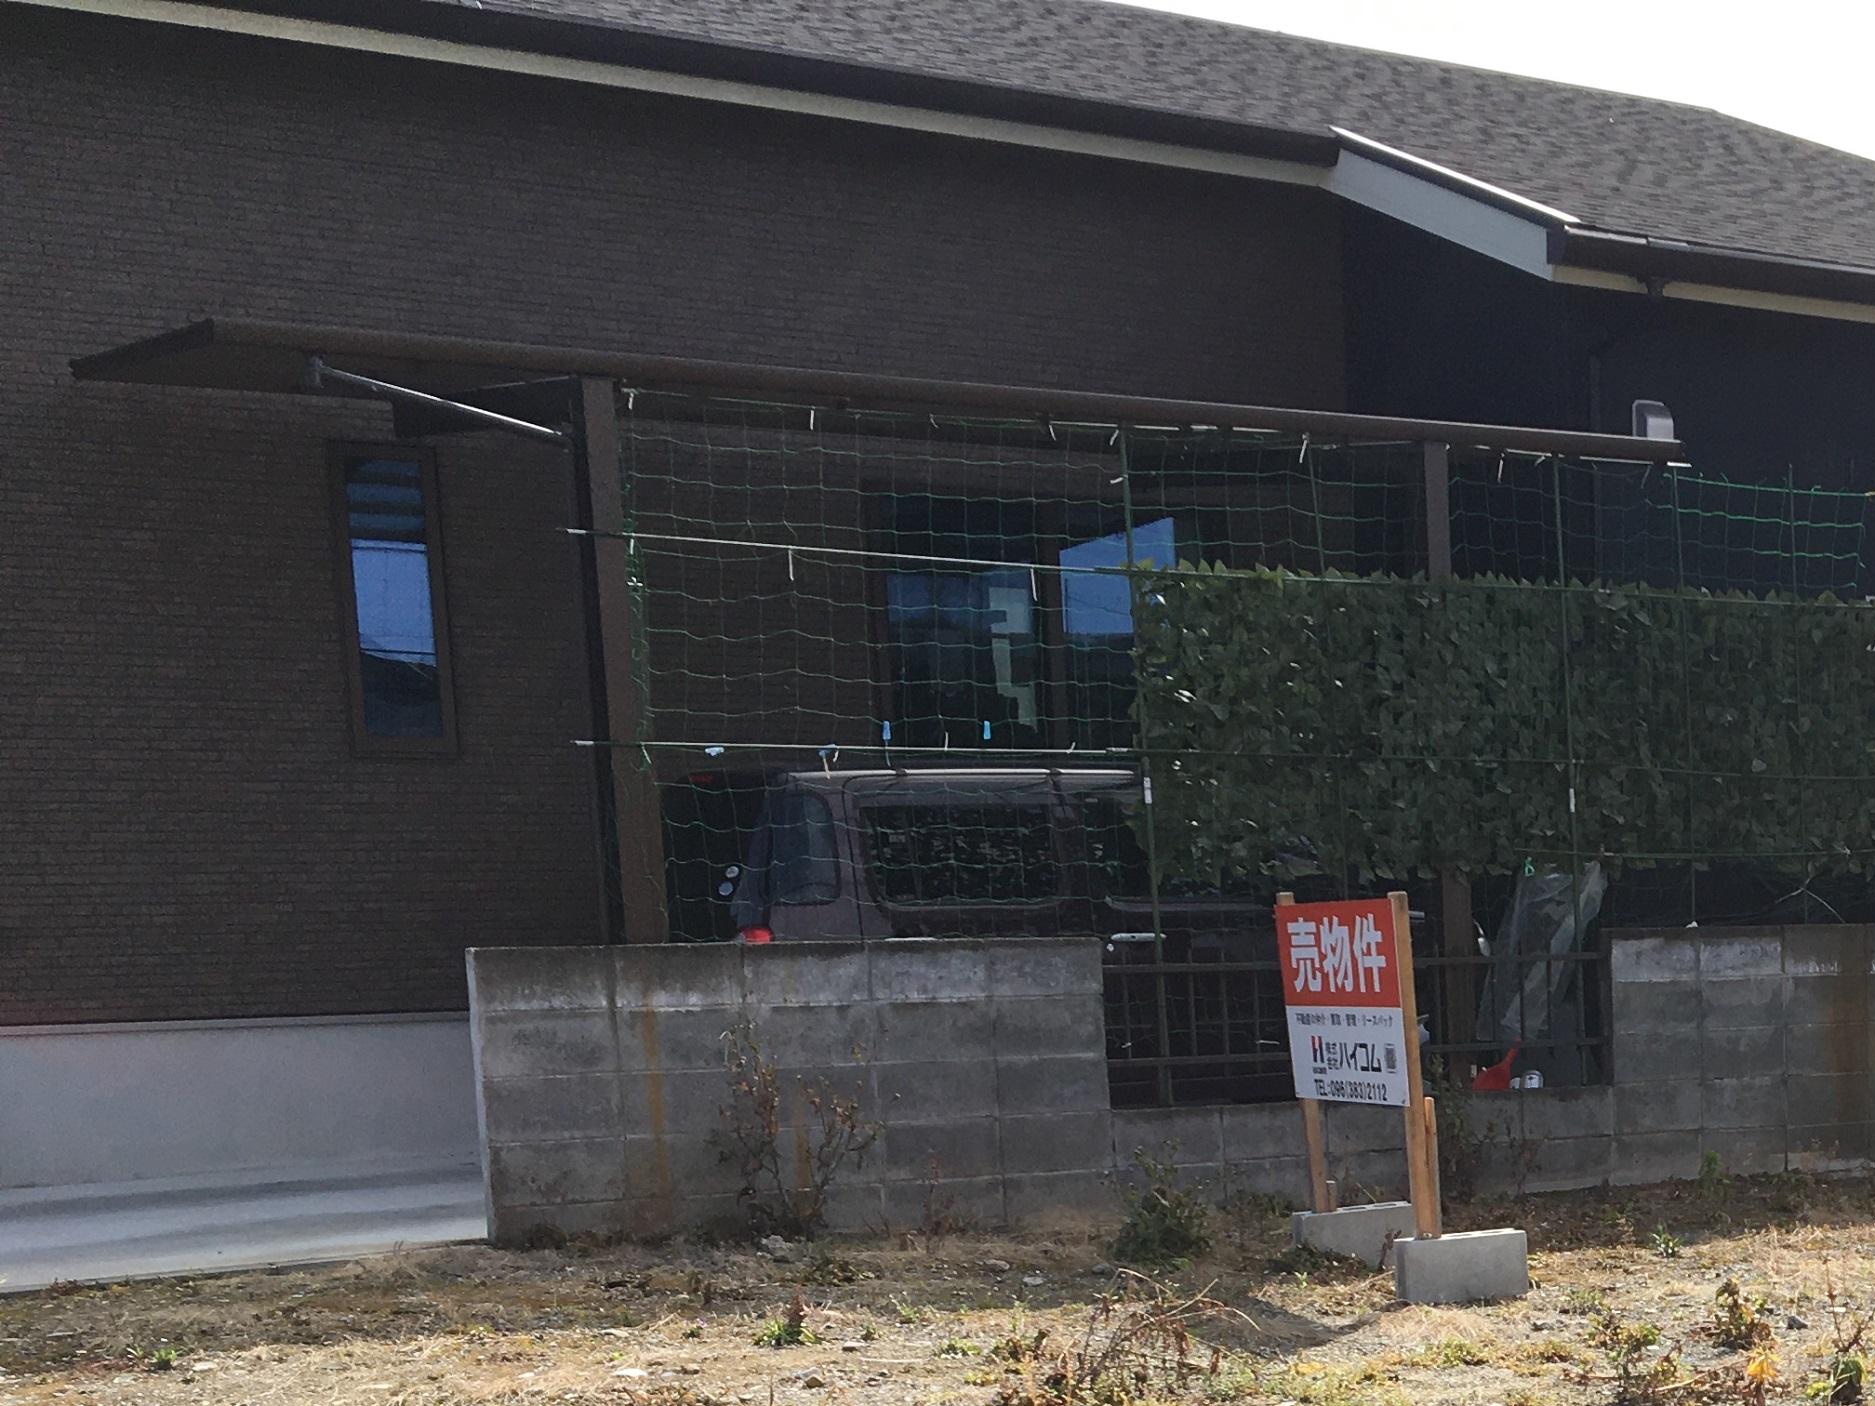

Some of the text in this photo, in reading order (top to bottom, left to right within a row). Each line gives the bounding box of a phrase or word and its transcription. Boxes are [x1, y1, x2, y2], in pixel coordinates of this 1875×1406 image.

[1286, 912, 1387, 993] 売物件
[1339, 1042, 1383, 1073] ハイコム
